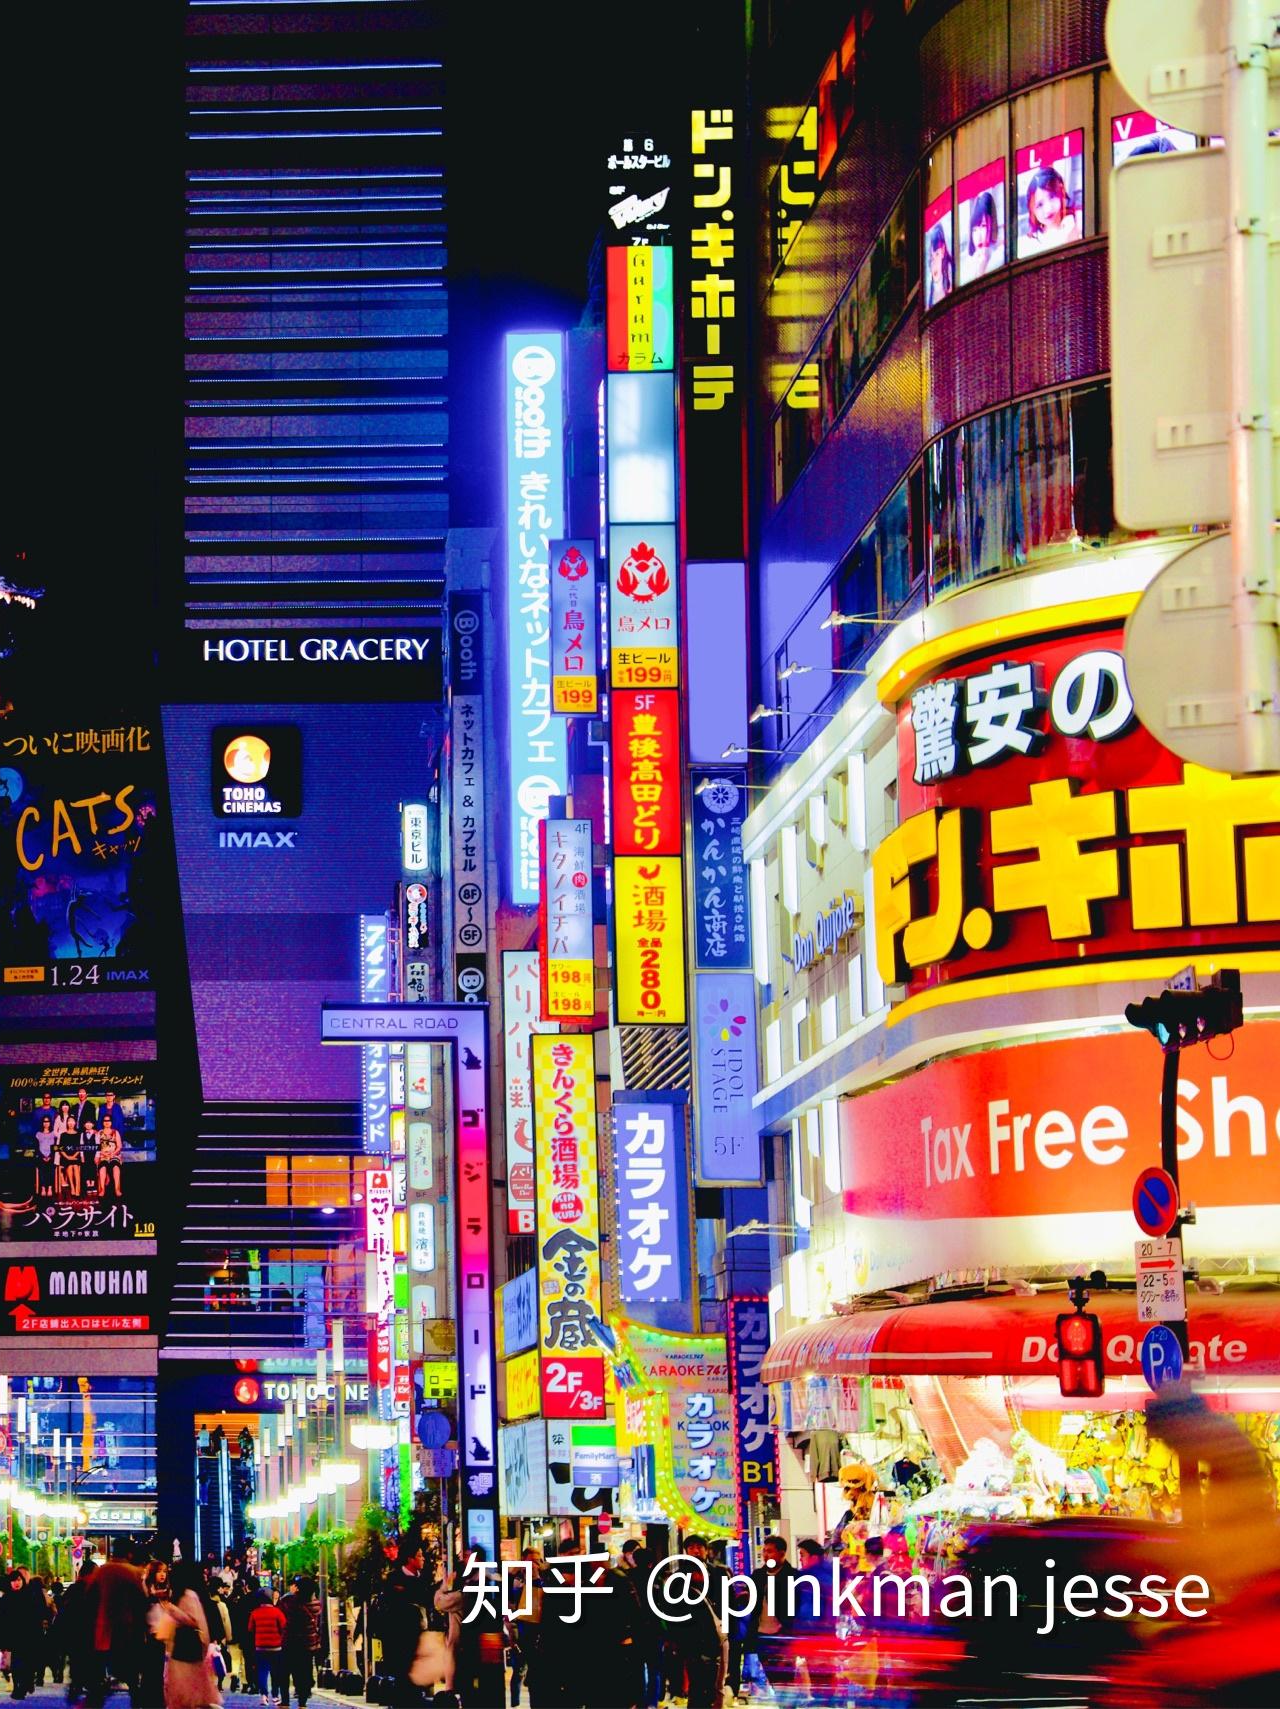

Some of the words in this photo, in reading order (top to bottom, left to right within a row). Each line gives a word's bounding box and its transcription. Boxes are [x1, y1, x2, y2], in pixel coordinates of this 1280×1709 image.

[562, 608, 585, 672] 鳥メロ
[617, 615, 672, 633] 鳥メロ
[202, 639, 295, 662] HOTEL
[299, 638, 430, 662] GRACERY
[453, 609, 480, 681] Booth
[617, 652, 672, 666] 生ビール
[561, 689, 593, 704] 199
[633, 694, 657, 711] 5F
[910, 649, 1136, 788] 驚安の
[3, 726, 151, 757] ついに映画化
[222, 787, 266, 801] TOHO
[627, 713, 665, 850] 豊後高田どり
[222, 801, 282, 814] CINEMAS
[15, 784, 136, 872] CATS
[218, 831, 298, 849] IMAX
[574, 823, 590, 835] 4F
[91, 836, 142, 860] キャッツ
[551, 830, 569, 955] キタノイチバ
[700, 818, 729, 958] かんかん商店
[632, 884, 669, 932] 酒場
[50, 964, 101, 987] 1.24
[106, 968, 150, 981] IMAX
[365, 924, 387, 990] 747
[639, 949, 662, 1010] 280
[330, 1017, 408, 1030] CENTRAL
[413, 1017, 459, 1030] ROAD
[711, 1047, 729, 1114] STAGE
[727, 1048, 744, 1101] IDOL
[550, 1043, 581, 1191] きんくら酒場
[919, 1113, 976, 1190] Tax
[988, 1098, 1130, 1178] Free
[1159, 1074, 1280, 1162] Sh
[713, 1135, 746, 1155] 5F
[23, 1203, 135, 1231] パラサイト
[623, 1112, 671, 1292] カラオケ
[134, 1222, 155, 1235] 1.10
[460, 1107, 486, 1401] ゴジラロード
[49, 1269, 148, 1296] MARUHAN
[542, 1227, 599, 1352] 金の蔵
[545, 1362, 584, 1394] 2F
[737, 1306, 770, 1453] カラオケ
[1148, 1342, 1165, 1386] P
[574, 1451, 617, 1462] FamilyMart
[685, 1392, 722, 1514] カラオケ
[742, 1460, 775, 1485] B1
